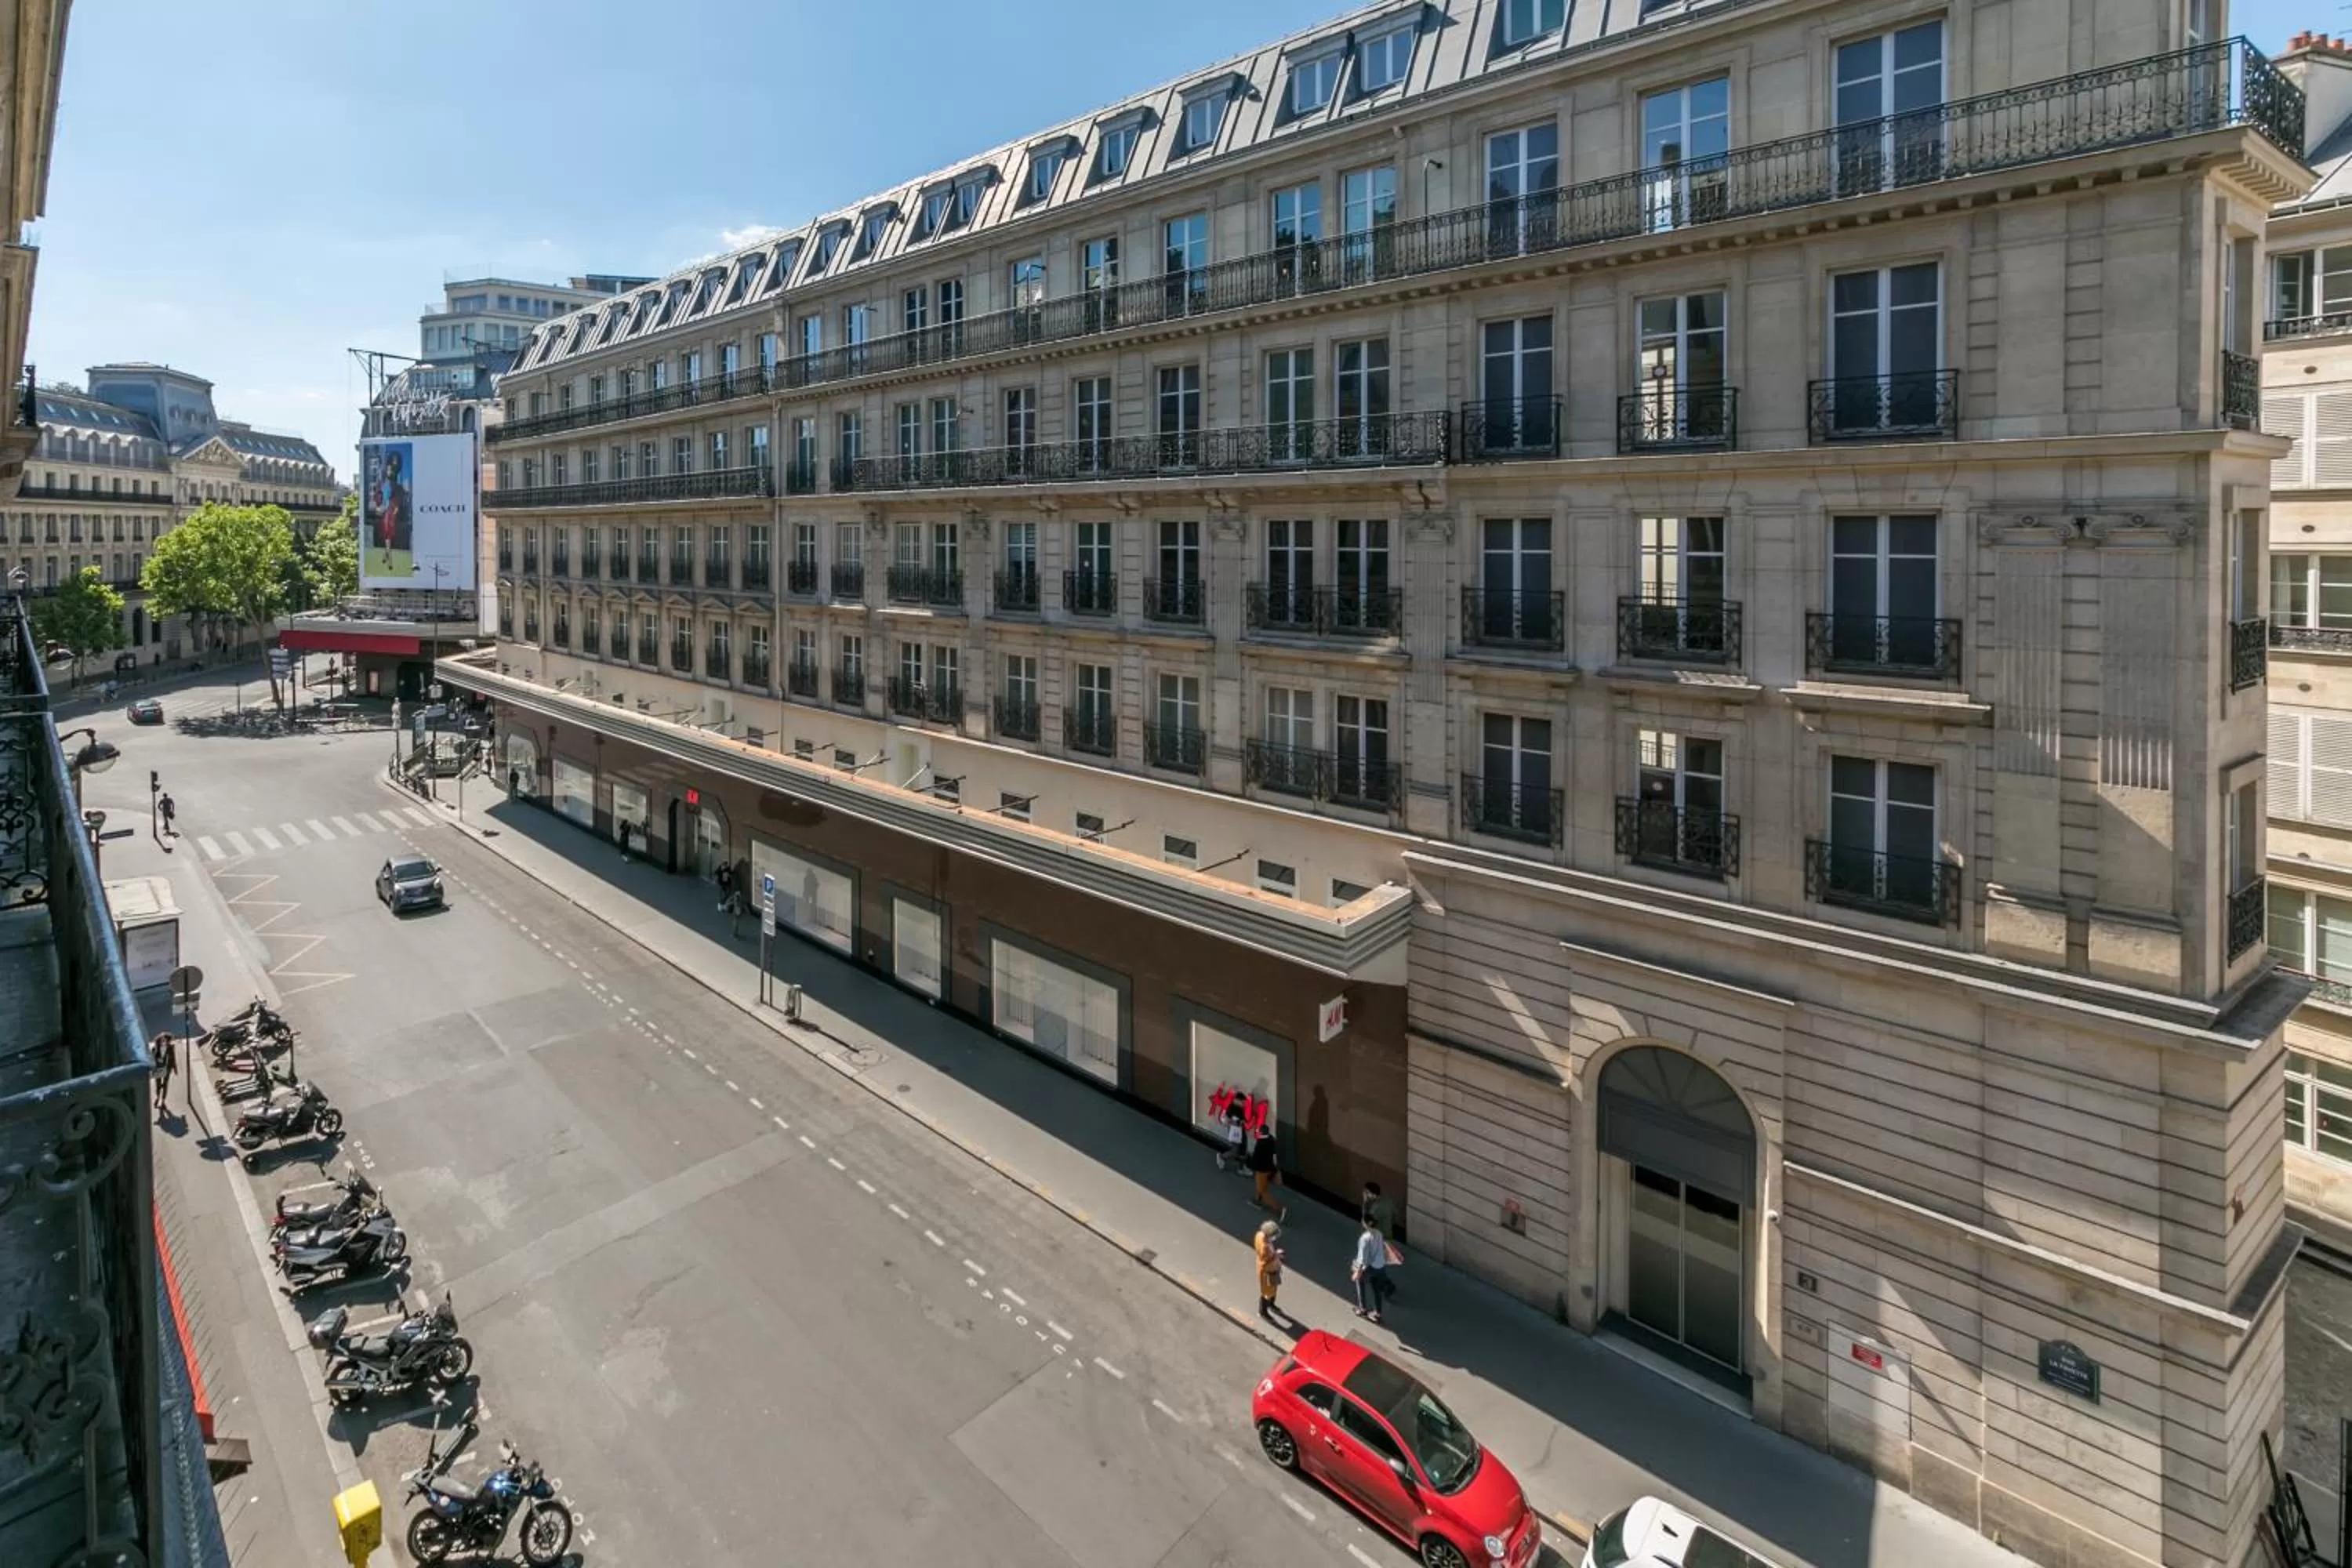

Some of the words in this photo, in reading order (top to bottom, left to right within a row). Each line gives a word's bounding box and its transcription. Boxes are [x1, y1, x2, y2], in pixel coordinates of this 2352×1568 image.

[419, 504, 466, 513] COACH
[1208, 1082, 1269, 1139] HM
[550, 1478, 596, 1547] MOTO
